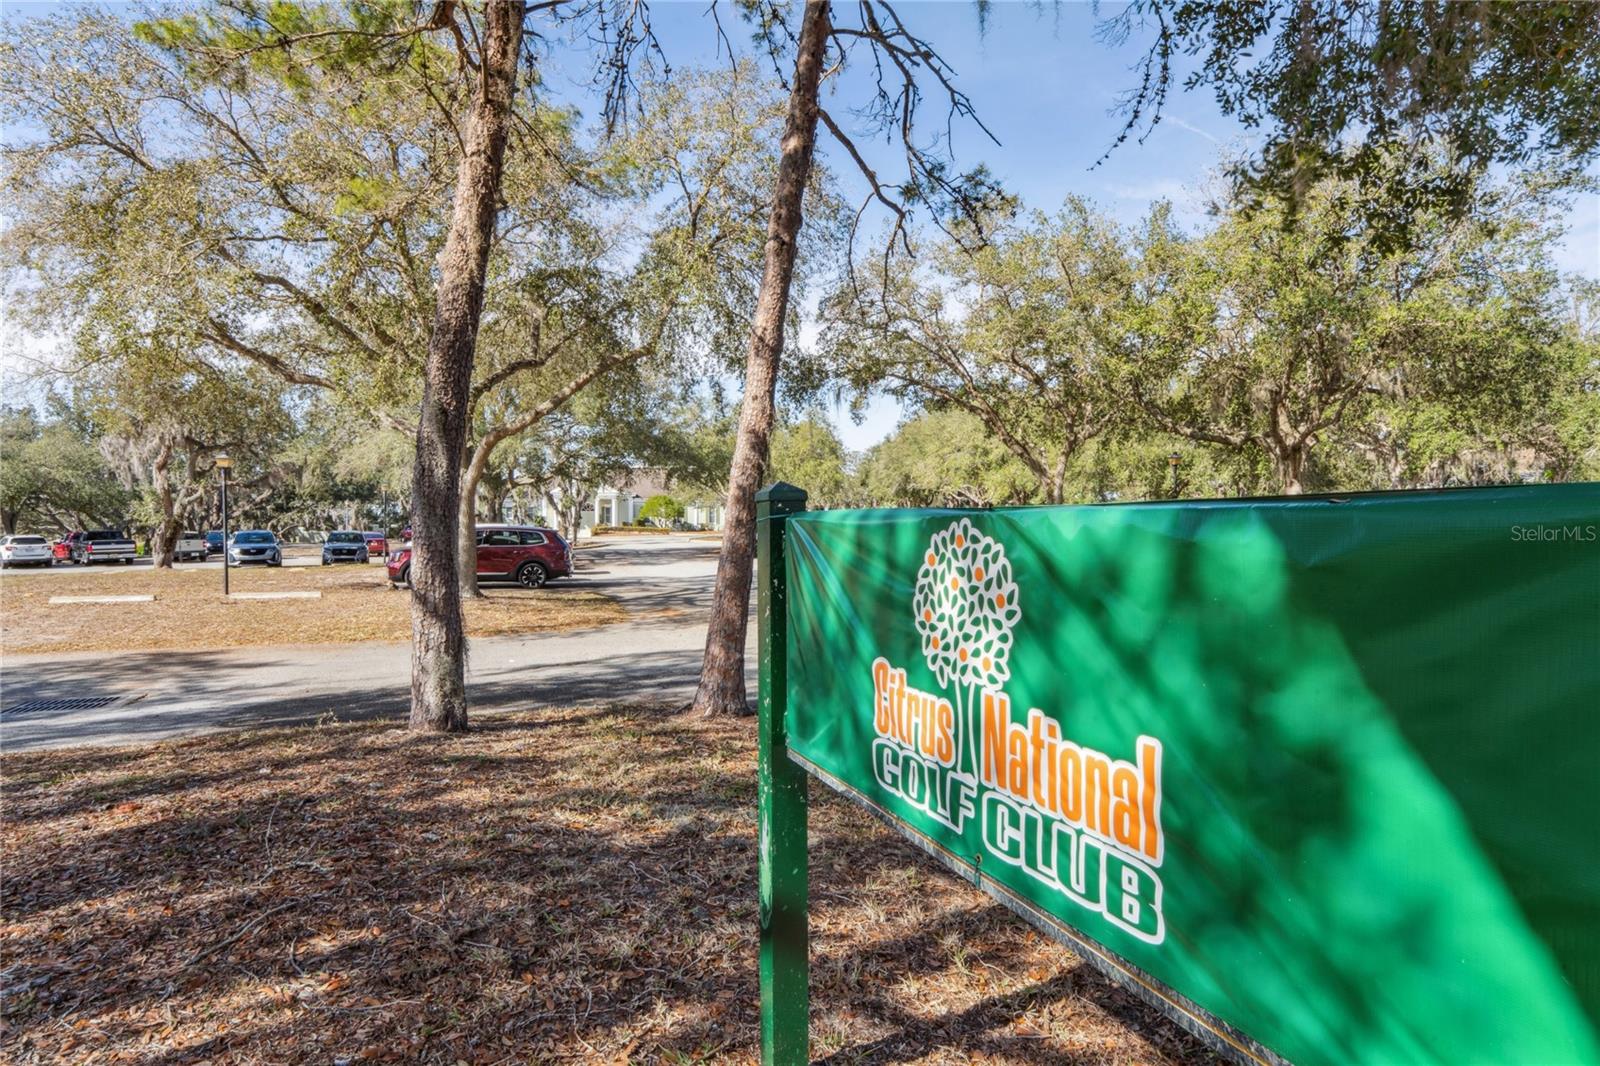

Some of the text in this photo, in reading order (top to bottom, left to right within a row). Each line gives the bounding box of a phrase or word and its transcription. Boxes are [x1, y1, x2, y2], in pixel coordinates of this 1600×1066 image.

[872, 738, 1165, 945] GOLF CLUB
[873, 658, 1162, 866] Citrus National
